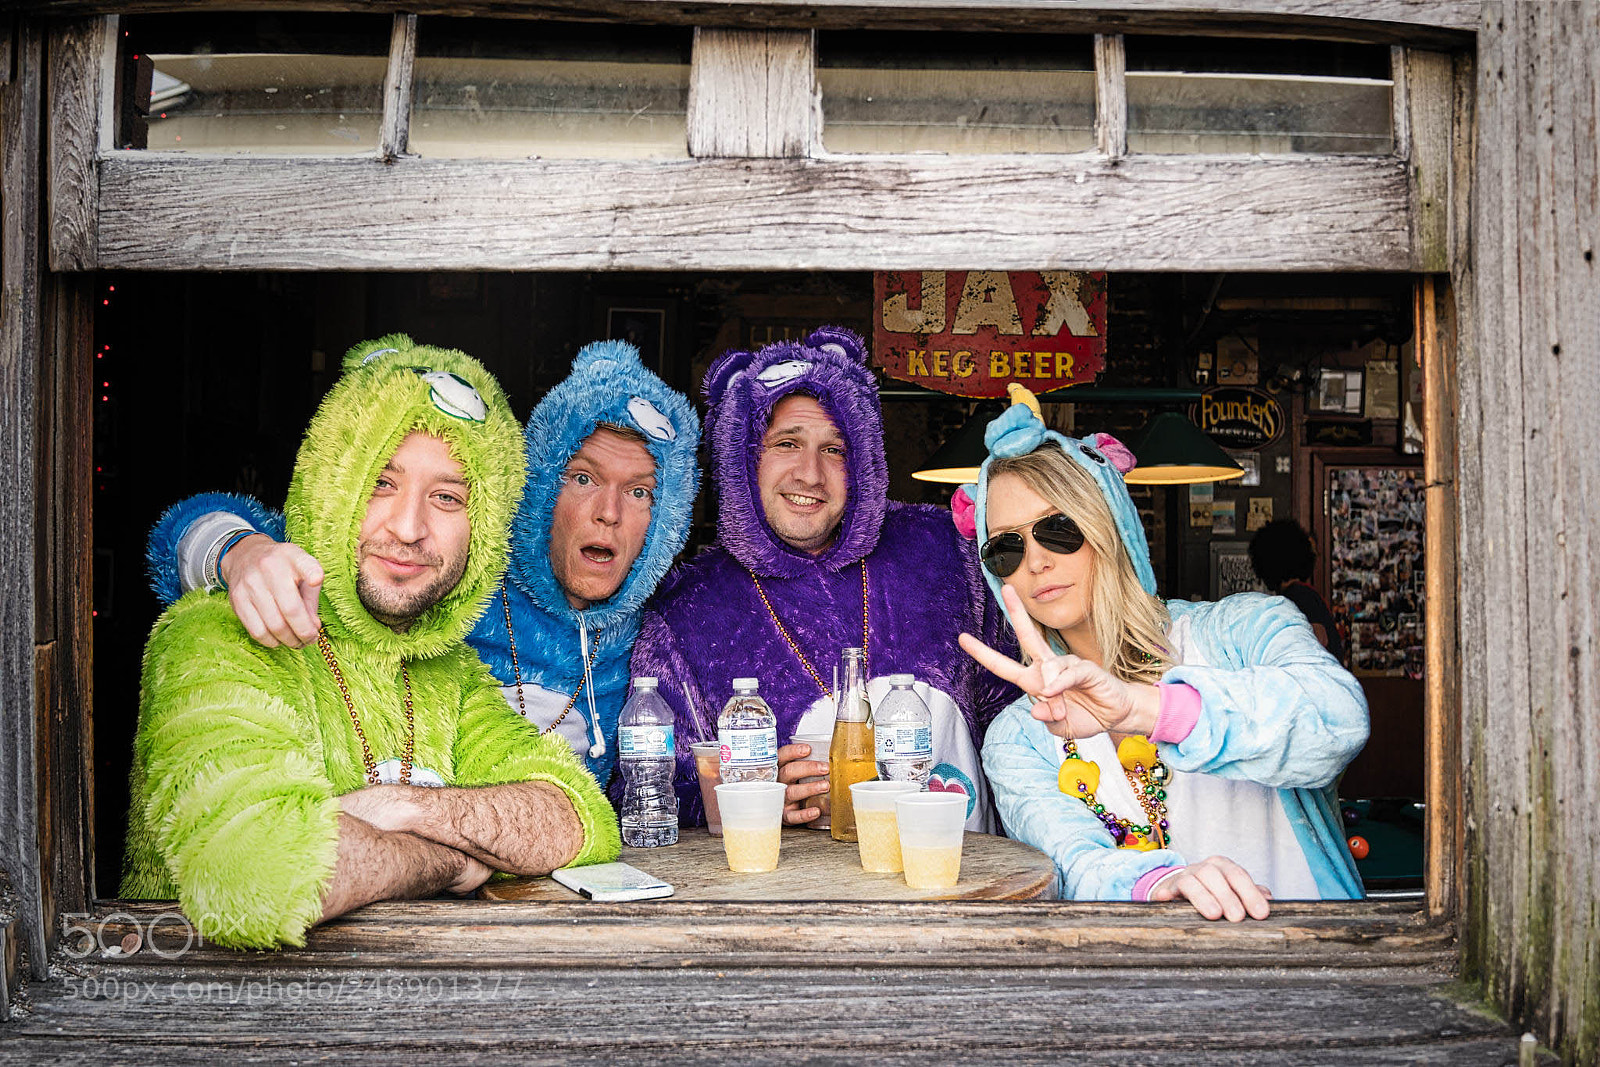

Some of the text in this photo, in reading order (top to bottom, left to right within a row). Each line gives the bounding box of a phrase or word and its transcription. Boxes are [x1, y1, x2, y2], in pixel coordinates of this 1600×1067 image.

[882, 271, 1098, 336] JAX
[908, 350, 1074, 379] KEG BEER
